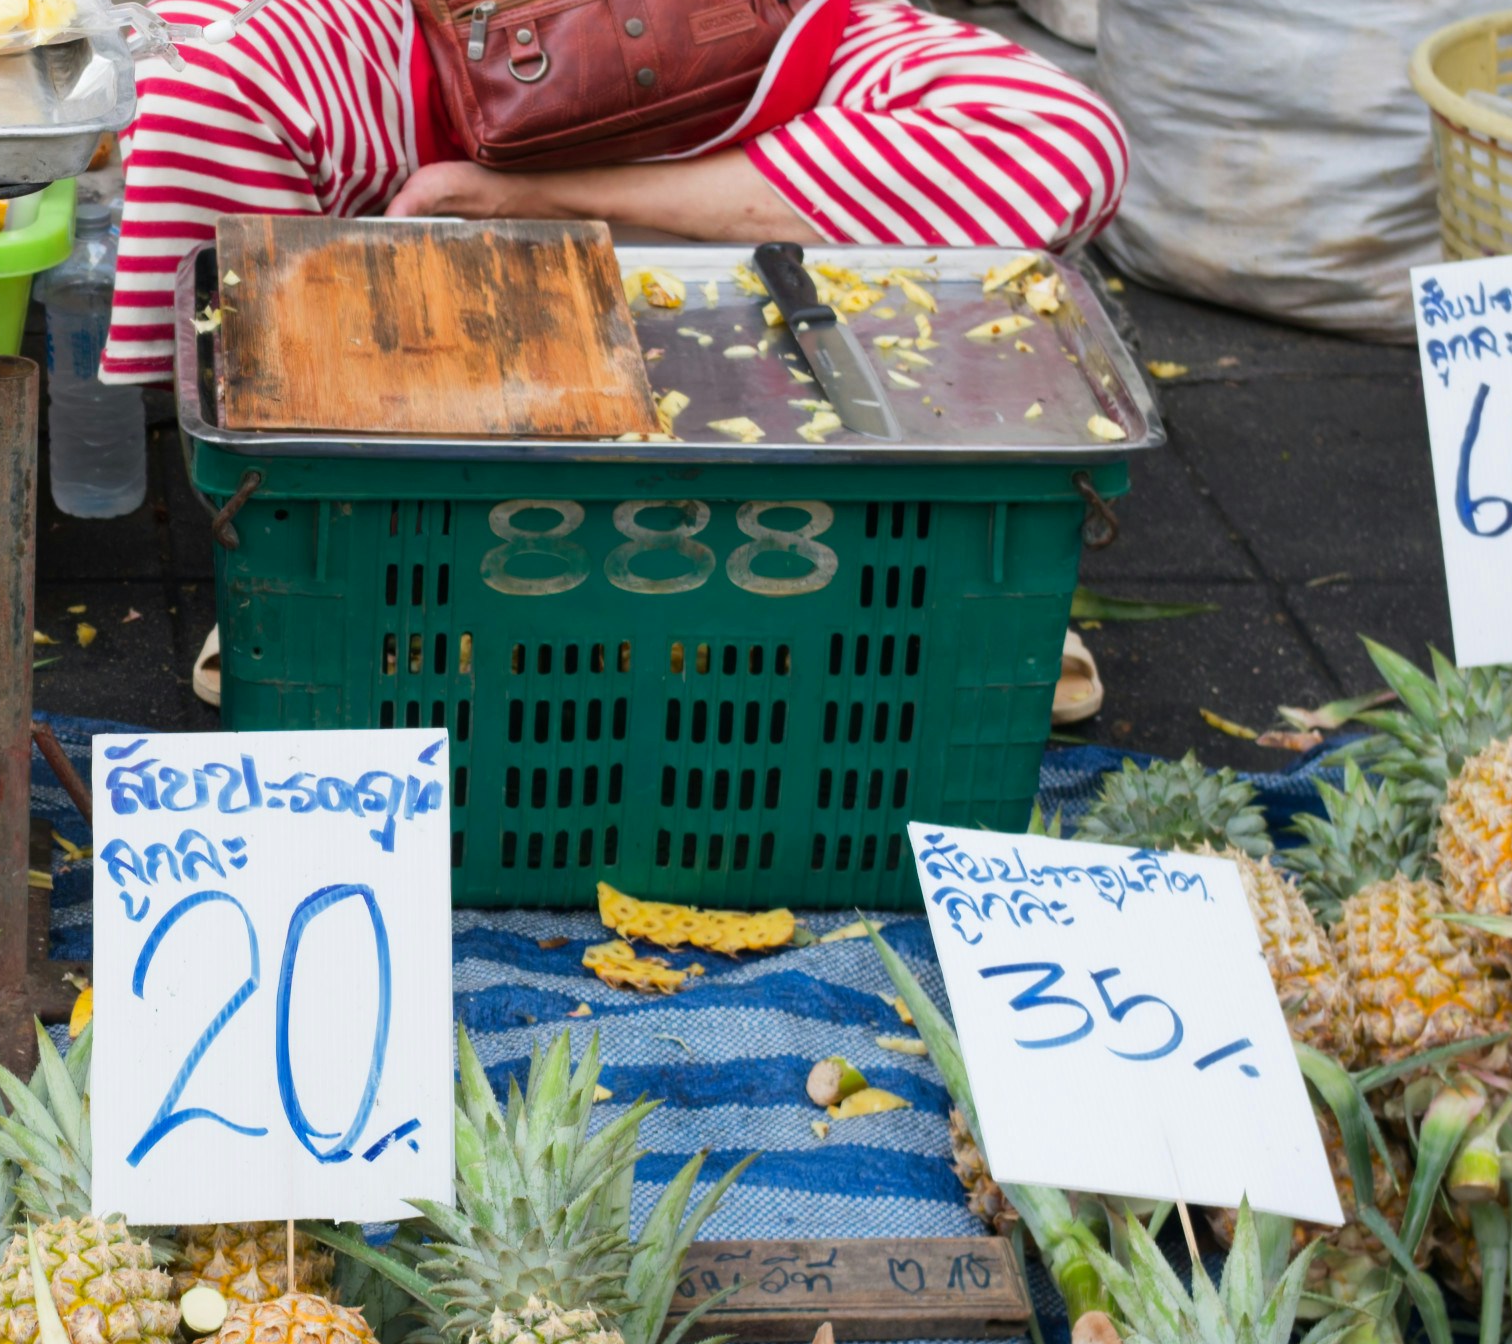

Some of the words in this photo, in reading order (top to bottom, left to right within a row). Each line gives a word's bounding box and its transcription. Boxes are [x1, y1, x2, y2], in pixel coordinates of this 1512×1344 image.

[479, 499, 839, 596] 888
[99, 827, 249, 922] ลูกละ
[931, 885, 1076, 946] ลูกละ
